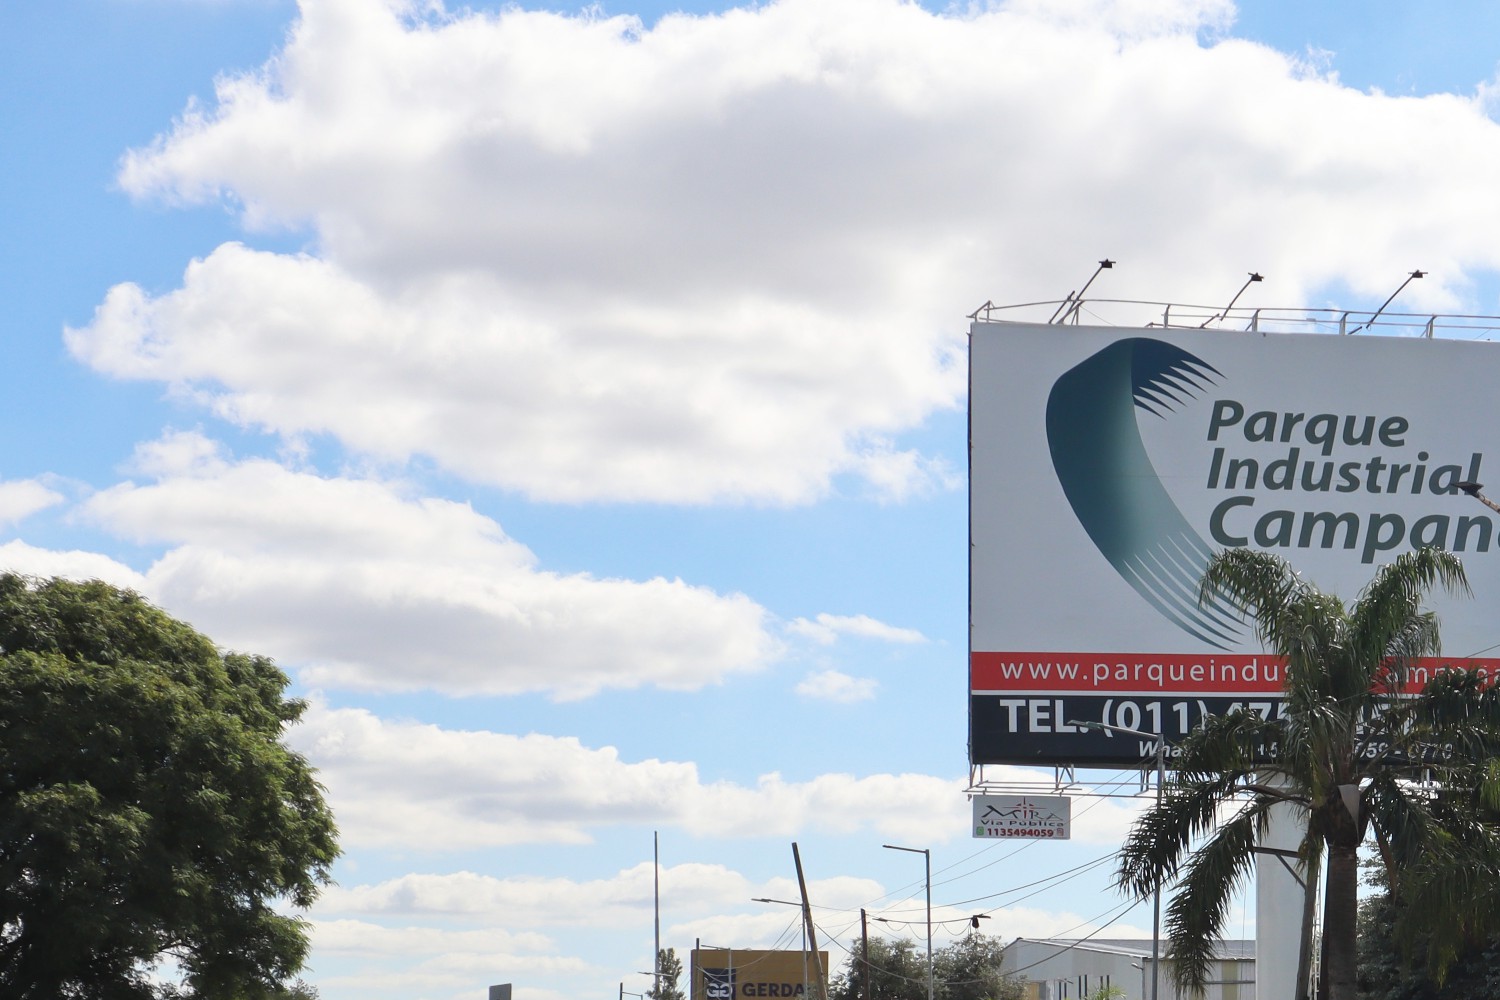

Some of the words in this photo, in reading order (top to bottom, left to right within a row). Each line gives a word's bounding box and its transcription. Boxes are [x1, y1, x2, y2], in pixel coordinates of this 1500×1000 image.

[1207, 400, 1409, 456] Parque
[1207, 448, 1482, 495] Industrial
[1000, 699, 1089, 733] TEL.
[1102, 699, 1208, 738] (011)
[987, 828, 1054, 837] 1135494059
[742, 983, 805, 998] GERDA
